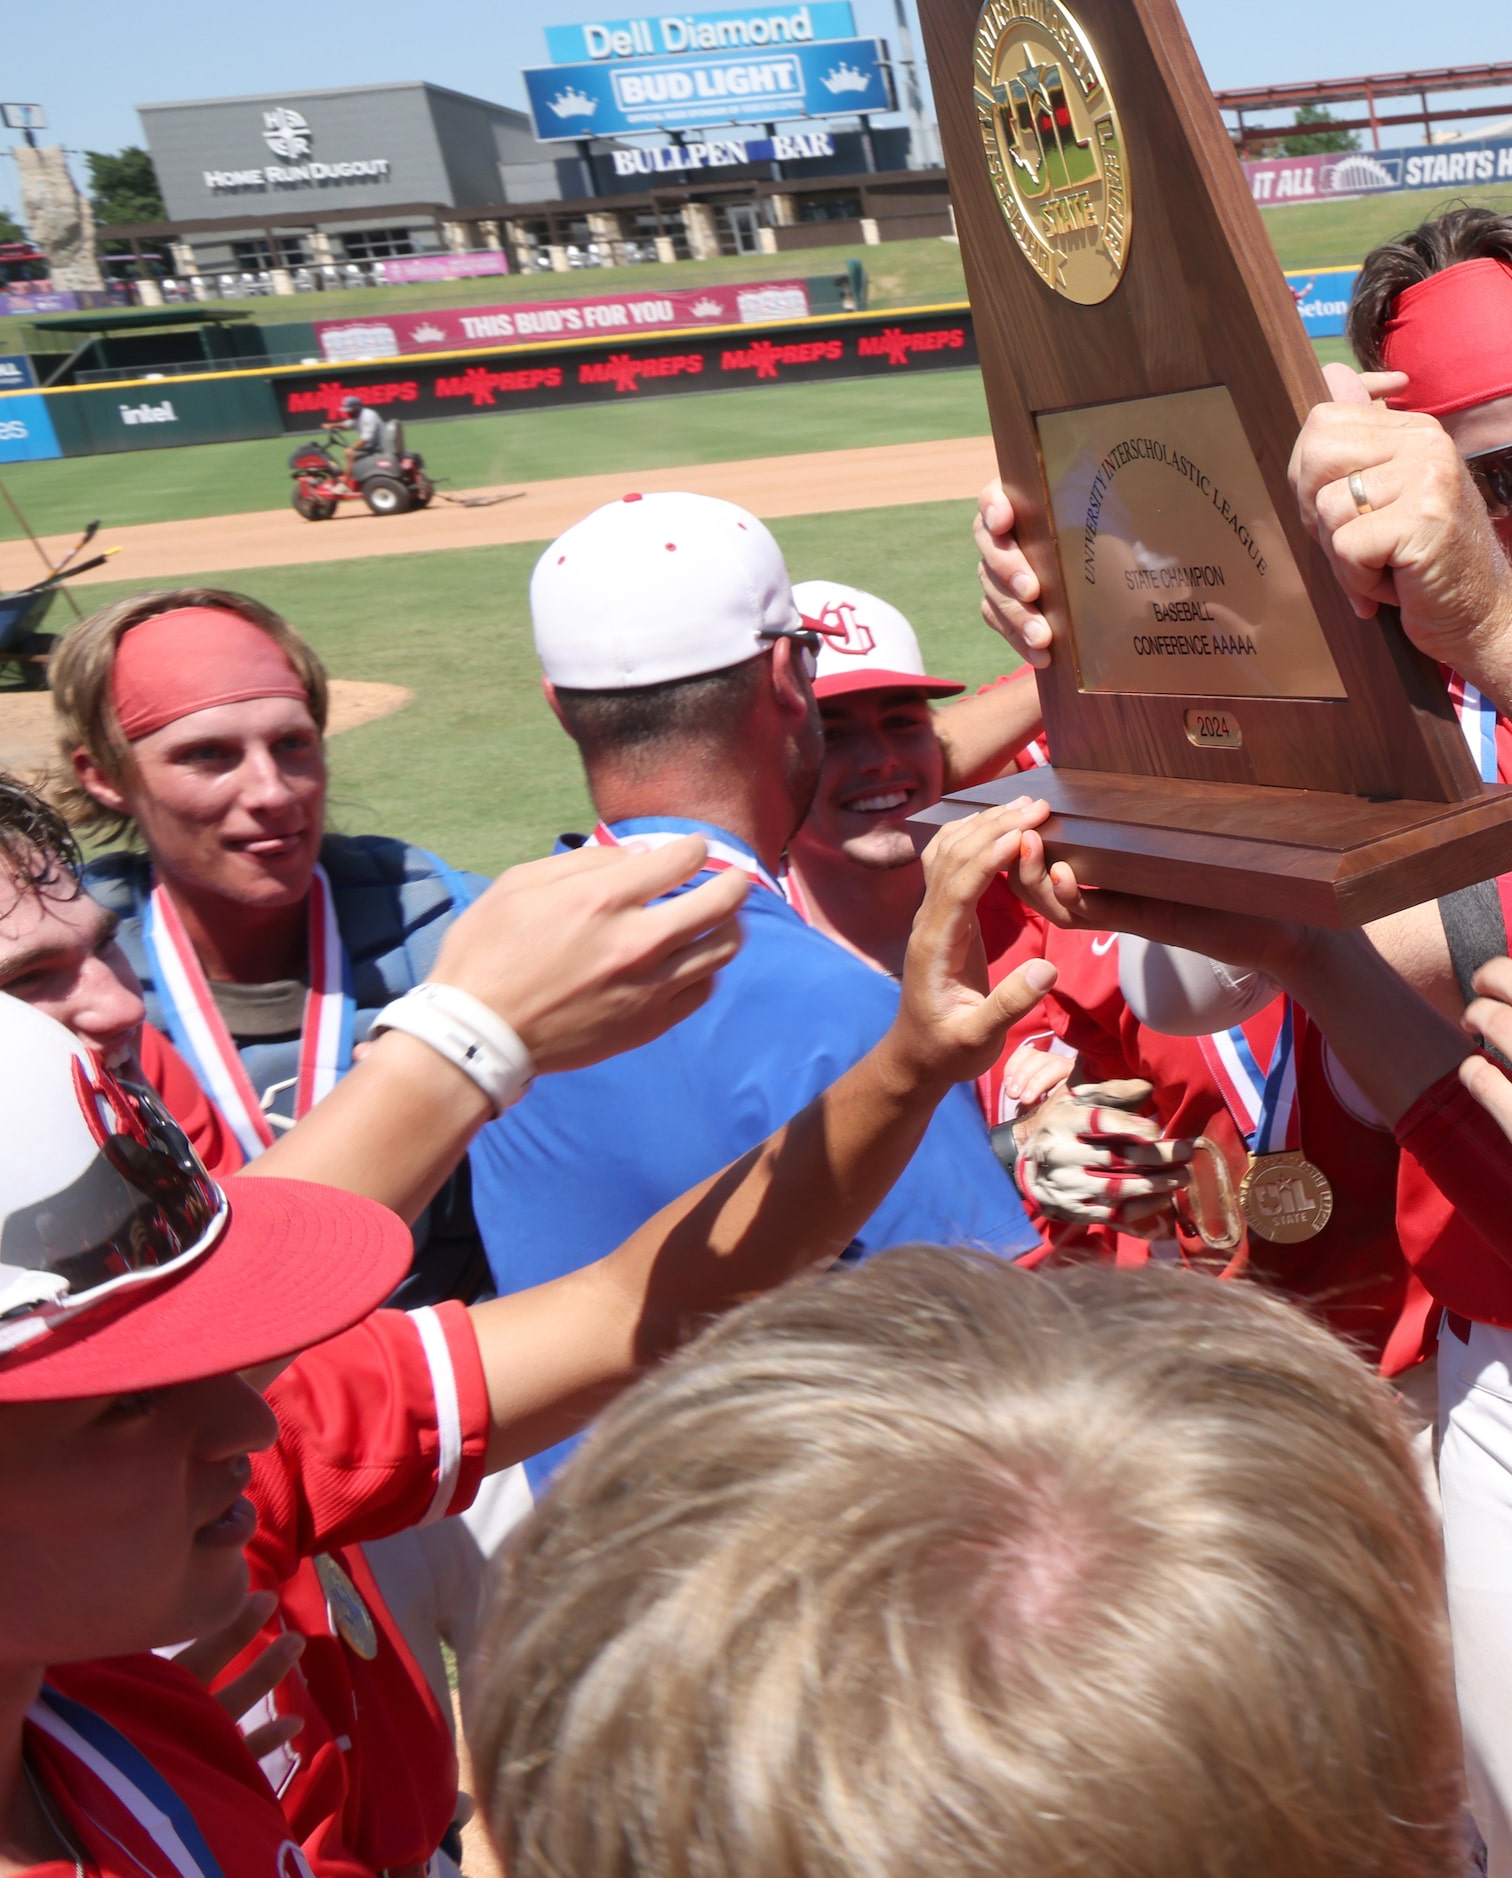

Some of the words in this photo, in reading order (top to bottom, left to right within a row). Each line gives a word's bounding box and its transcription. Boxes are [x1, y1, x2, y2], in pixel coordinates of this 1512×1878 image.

[583, 20, 652, 60] Dell
[661, 7, 815, 53] Diamond
[618, 70, 696, 103] BUD
[702, 62, 796, 96] LIGHT
[612, 139, 749, 176] BULLPEN
[770, 132, 835, 161] BAR
[1253, 172, 1276, 200] IT
[1276, 168, 1316, 198] ALL
[1405, 152, 1495, 187] STARTS
[1040, 190, 1099, 238] STATE
[460, 313, 515, 339] THIS
[514, 307, 581, 334] BUD'S
[582, 302, 628, 328] FOR
[629, 299, 674, 325] YOU
[1084, 475, 1108, 585] UNIVERSITY
[1101, 437, 1211, 497] INTERSCHOLASTIC
[1212, 488, 1269, 577] LEAGUE
[1125, 567, 1160, 590] STATE
[1160, 565, 1225, 587] CHAMPION
[1152, 601, 1215, 622] BASEBALL
[1133, 635, 1212, 656] CONFERENCE
[1212, 634, 1257, 656] AAAAA
[1197, 716, 1230, 738] 2024
[1254, 1178, 1316, 1216] UIL
[1272, 1212, 1309, 1227] STATE
